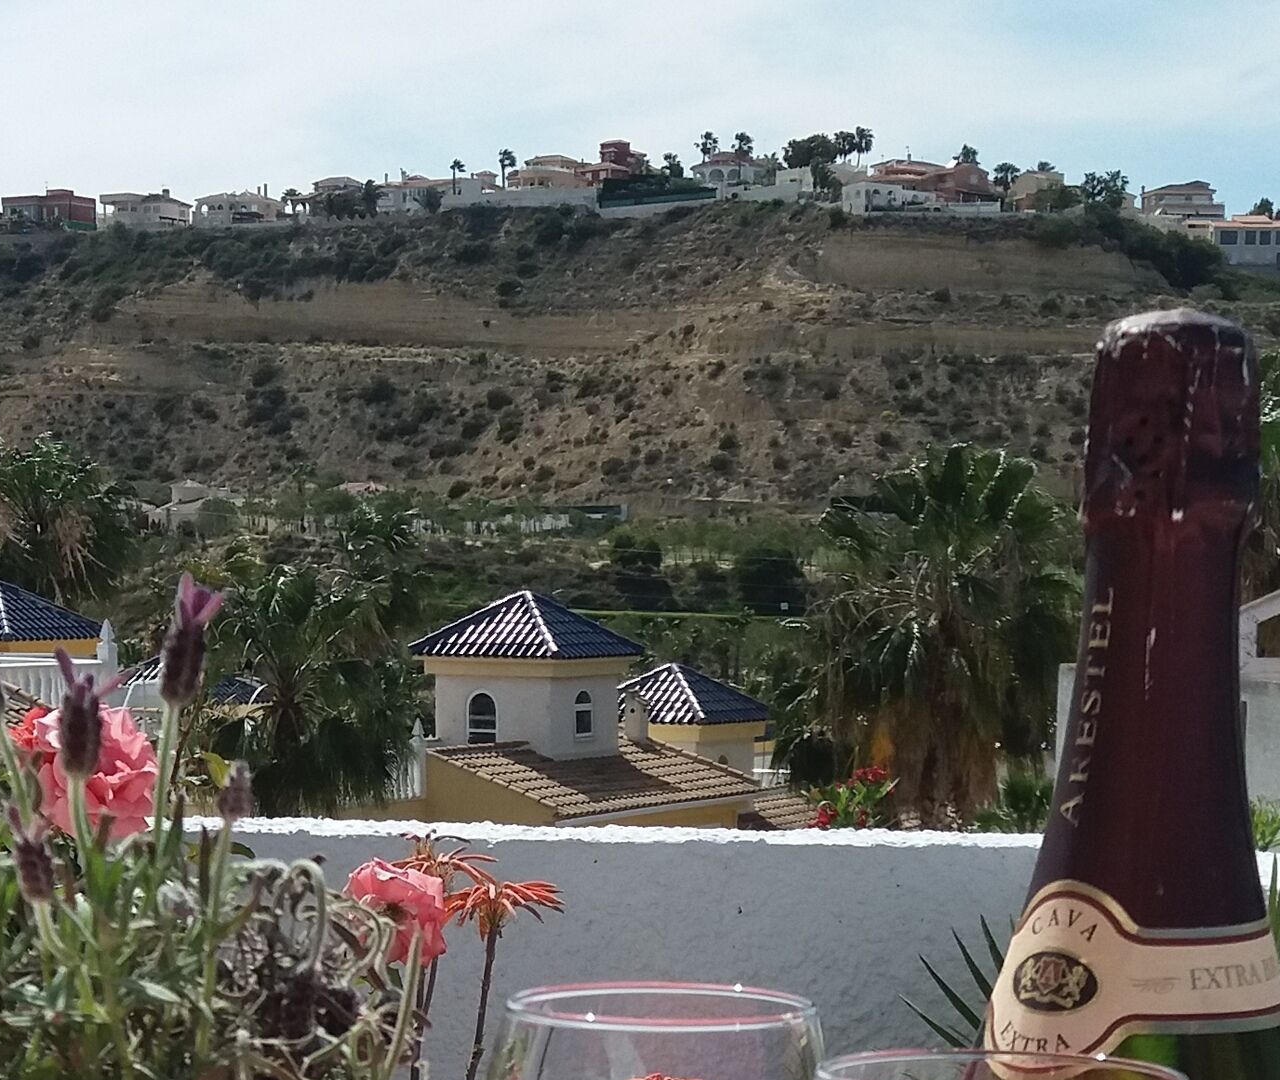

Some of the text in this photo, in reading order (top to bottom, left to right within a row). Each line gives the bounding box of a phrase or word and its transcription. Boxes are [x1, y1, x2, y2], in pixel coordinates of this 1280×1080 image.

[1060, 587, 1114, 828] ARESTEL
[1031, 908, 1098, 942] CAVA
[1190, 962, 1262, 990] EXTRA
[1000, 1019, 1070, 1053] EXTRA
